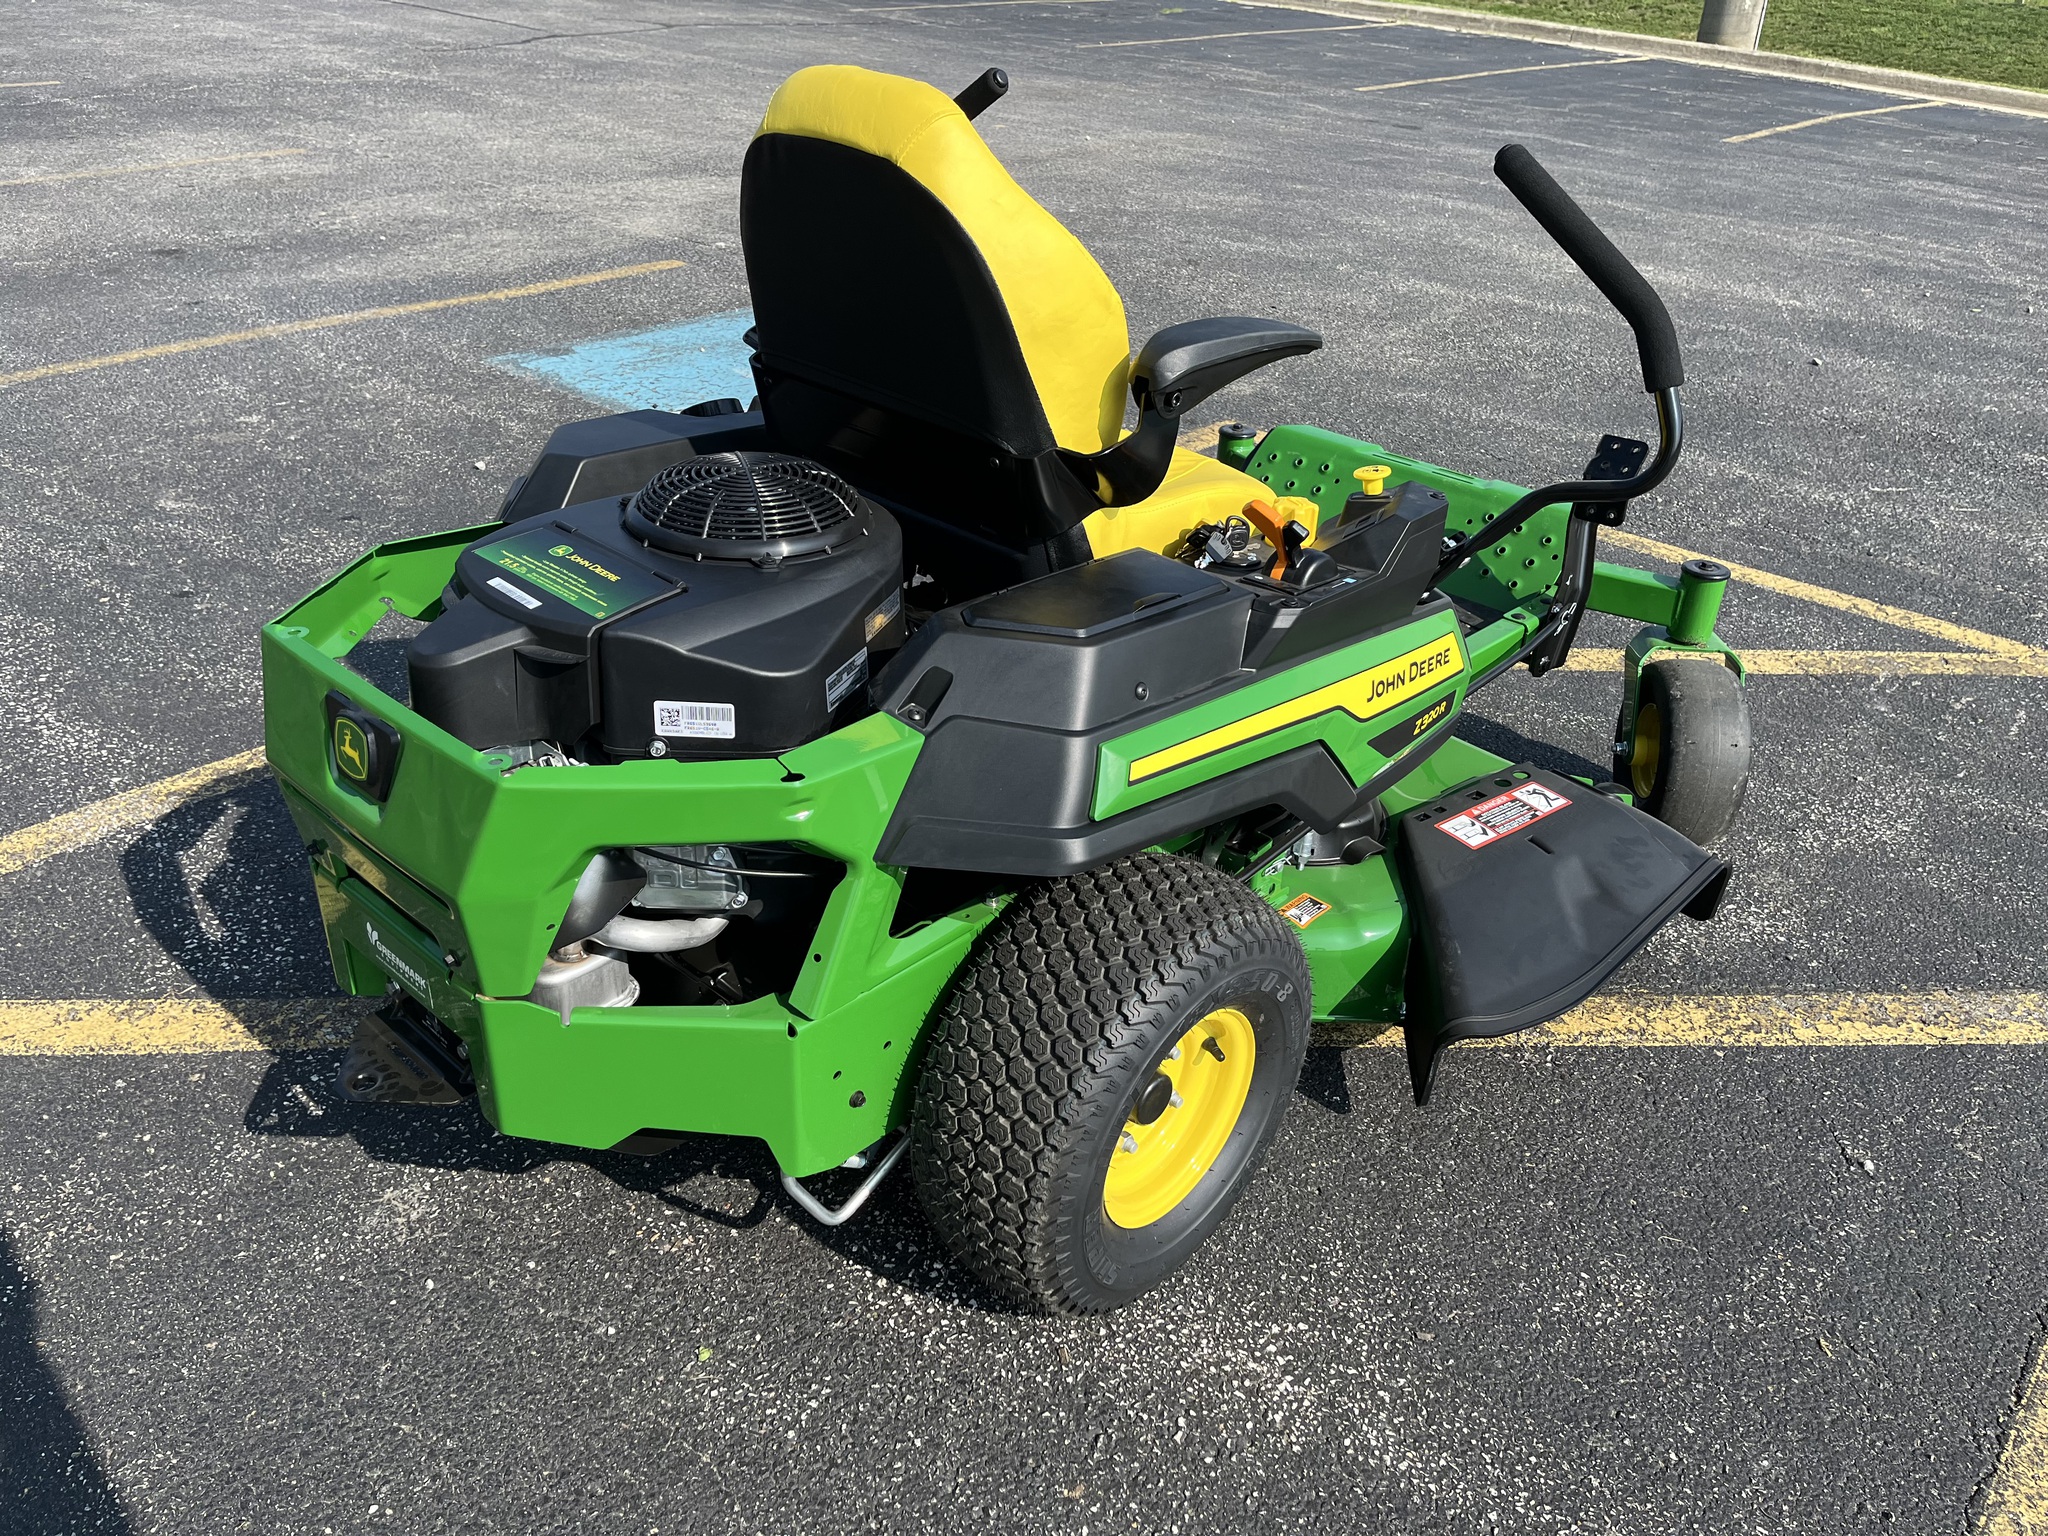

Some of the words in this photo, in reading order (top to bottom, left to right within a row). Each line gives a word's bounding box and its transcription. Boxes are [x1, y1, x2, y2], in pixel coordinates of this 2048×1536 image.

[565, 553, 592, 570] JOHN
[589, 564, 622, 582] DEERE
[1367, 669, 1406, 703] JOHN
[1408, 647, 1451, 684] DEERE
[1412, 699, 1447, 736] Z320R
[1478, 795, 1510, 812] DANGER
[376, 940, 427, 989] GREENMARK
